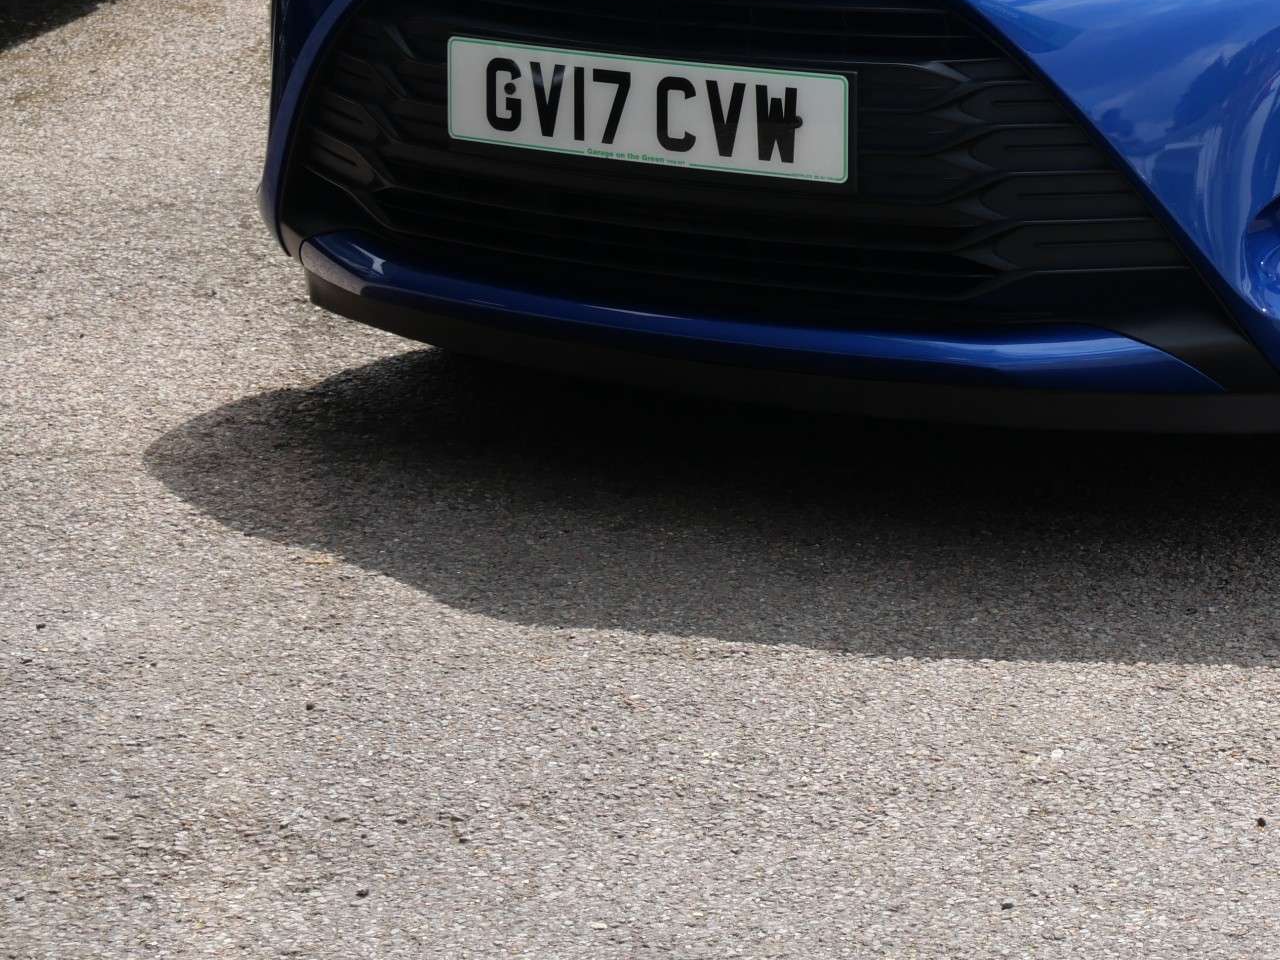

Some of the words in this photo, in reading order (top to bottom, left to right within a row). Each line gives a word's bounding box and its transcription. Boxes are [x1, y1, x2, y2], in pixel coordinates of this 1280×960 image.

[485, 57, 632, 145] GV17
[656, 76, 799, 164] CVW
[641, 153, 665, 163] Green
